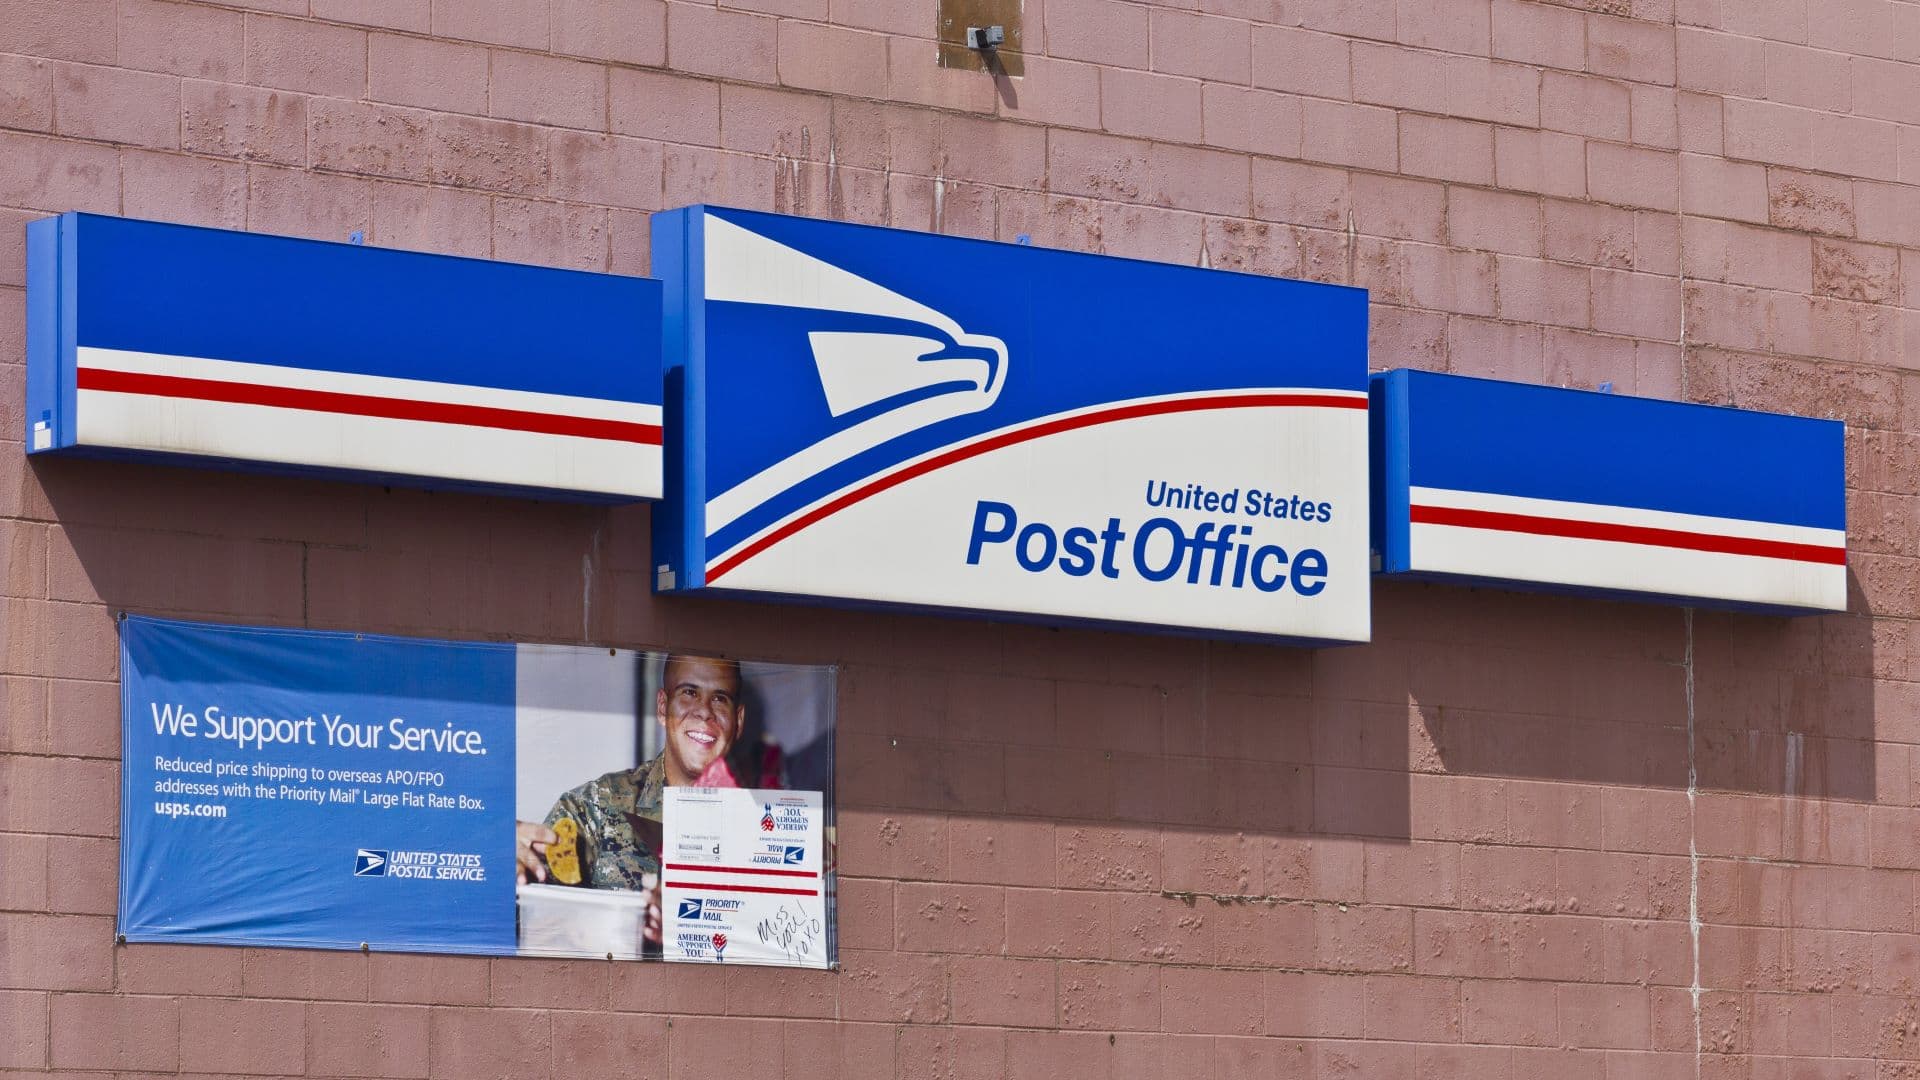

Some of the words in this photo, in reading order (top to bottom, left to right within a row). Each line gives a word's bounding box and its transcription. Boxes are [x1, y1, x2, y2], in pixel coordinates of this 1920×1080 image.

[1146, 480, 1239, 513] United
[1244, 489, 1332, 523] States
[966, 500, 1125, 579] Post
[1132, 517, 1328, 596] Office
[151, 702, 198, 737] We
[204, 706, 316, 750] Support
[322, 714, 384, 748] Your
[389, 718, 487, 755] Service.
[155, 755, 212, 774] Reduced
[216, 760, 248, 777] price
[252, 761, 307, 782] shipping
[311, 767, 325, 781] to
[328, 770, 382, 784] overseas
[385, 770, 444, 787] APO/FPO
[155, 778, 219, 796] addresses
[223, 782, 250, 797] with
[255, 784, 276, 799] the
[280, 785, 326, 805] Priority
[363, 790, 399, 808] Large
[402, 791, 424, 808] Flat
[428, 793, 455, 808] Rate
[459, 795, 485, 810] Box.
[155, 801, 227, 819] usps.com
[783, 808, 802, 816] YOU
[776, 823, 809, 831] AMERICA
[767, 844, 784, 852] MAIL
[391, 850, 438, 865] UNITED
[437, 853, 482, 867] STATES
[387, 865, 434, 879] POSTAL
[703, 911, 723, 922] MAIL
[677, 933, 711, 943] AMERICA
[677, 941, 712, 950] SUPPORTS
[685, 948, 704, 958] YOU
